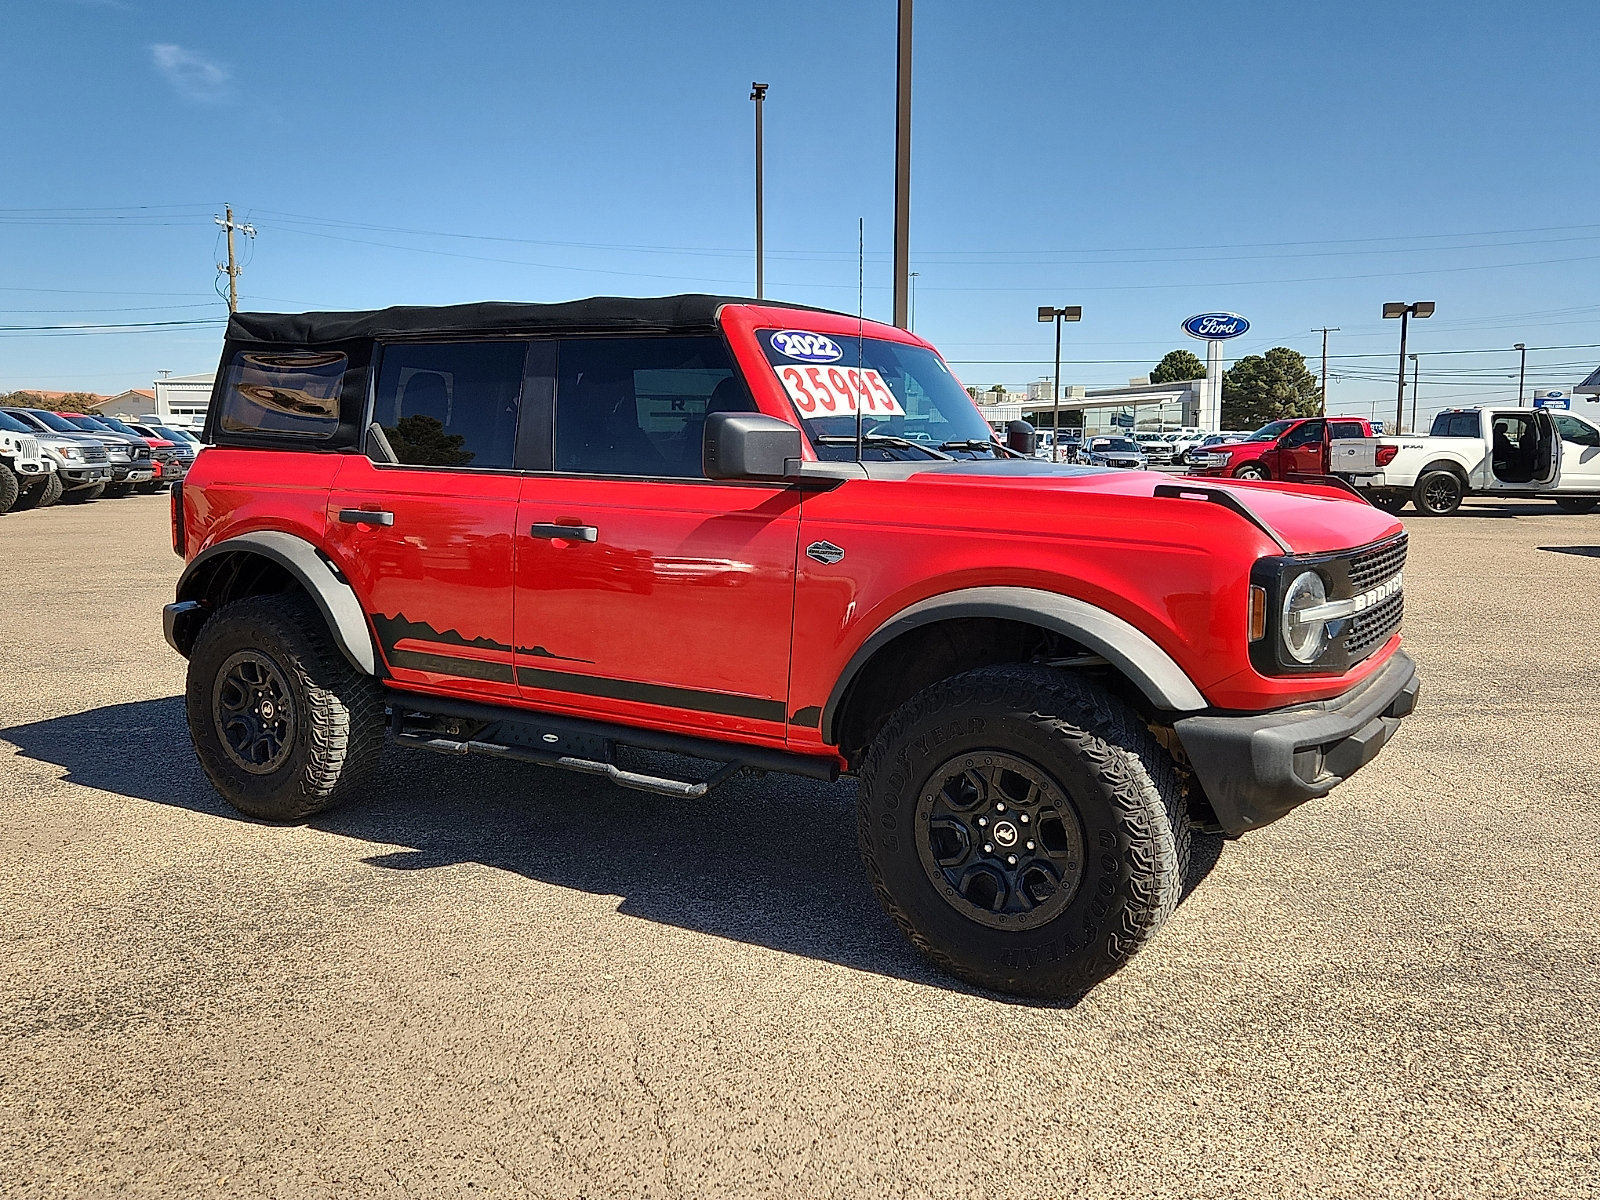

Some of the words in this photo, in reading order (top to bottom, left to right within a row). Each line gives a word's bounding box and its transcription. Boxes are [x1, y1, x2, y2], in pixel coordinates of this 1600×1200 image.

[1198, 317, 1239, 334] Ford
[775, 334, 839, 357] 2022
[783, 367, 895, 413] 35995
